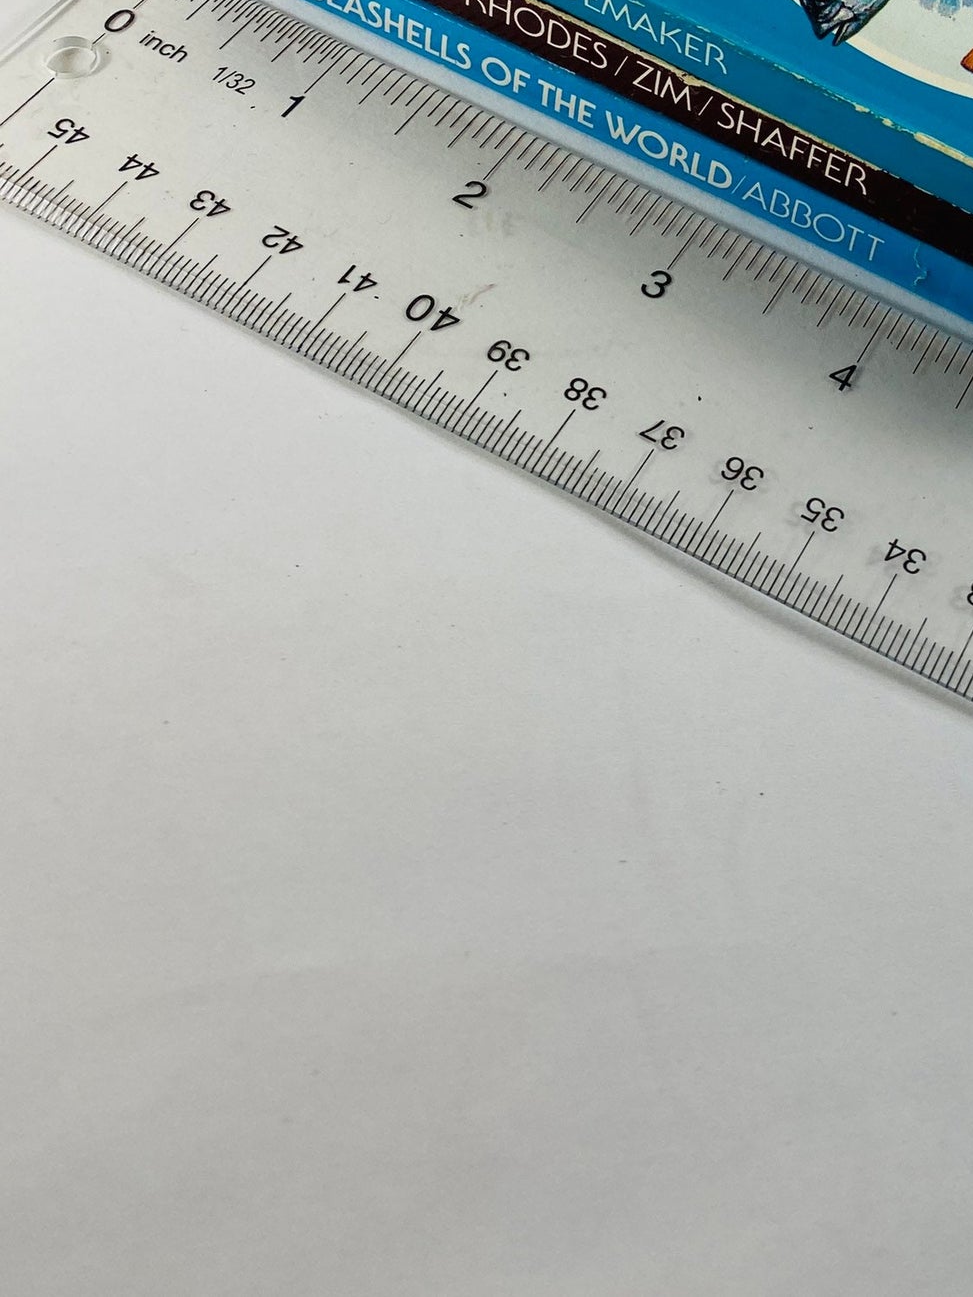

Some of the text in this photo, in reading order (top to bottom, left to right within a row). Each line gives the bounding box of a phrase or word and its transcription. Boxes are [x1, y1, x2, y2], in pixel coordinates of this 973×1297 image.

[139, 30, 256, 95] inch 1/32
[481, 56, 531, 99] OF
[538, 78, 597, 129] THE
[47, 118, 90, 145] 45
[633, 60, 692, 112] ZIM
[717, 102, 868, 195] SHAFFER
[118, 153, 160, 181] 44
[104, 9, 136, 32] 0
[281, 95, 306, 118] 1
[453, 180, 488, 209] 2
[641, 270, 673, 299] 3
[828, 364, 859, 392] 4
[189, 189, 232, 217] 43
[261, 225, 304, 255] 42
[337, 263, 378, 292] 41
[406, 294, 461, 332] 40
[487, 339, 530, 371] 39
[565, 377, 608, 411] 38
[638, 419, 685, 451] 37
[720, 456, 765, 491] 36
[800, 497, 845, 533] 35
[883, 538, 927, 575] 34
